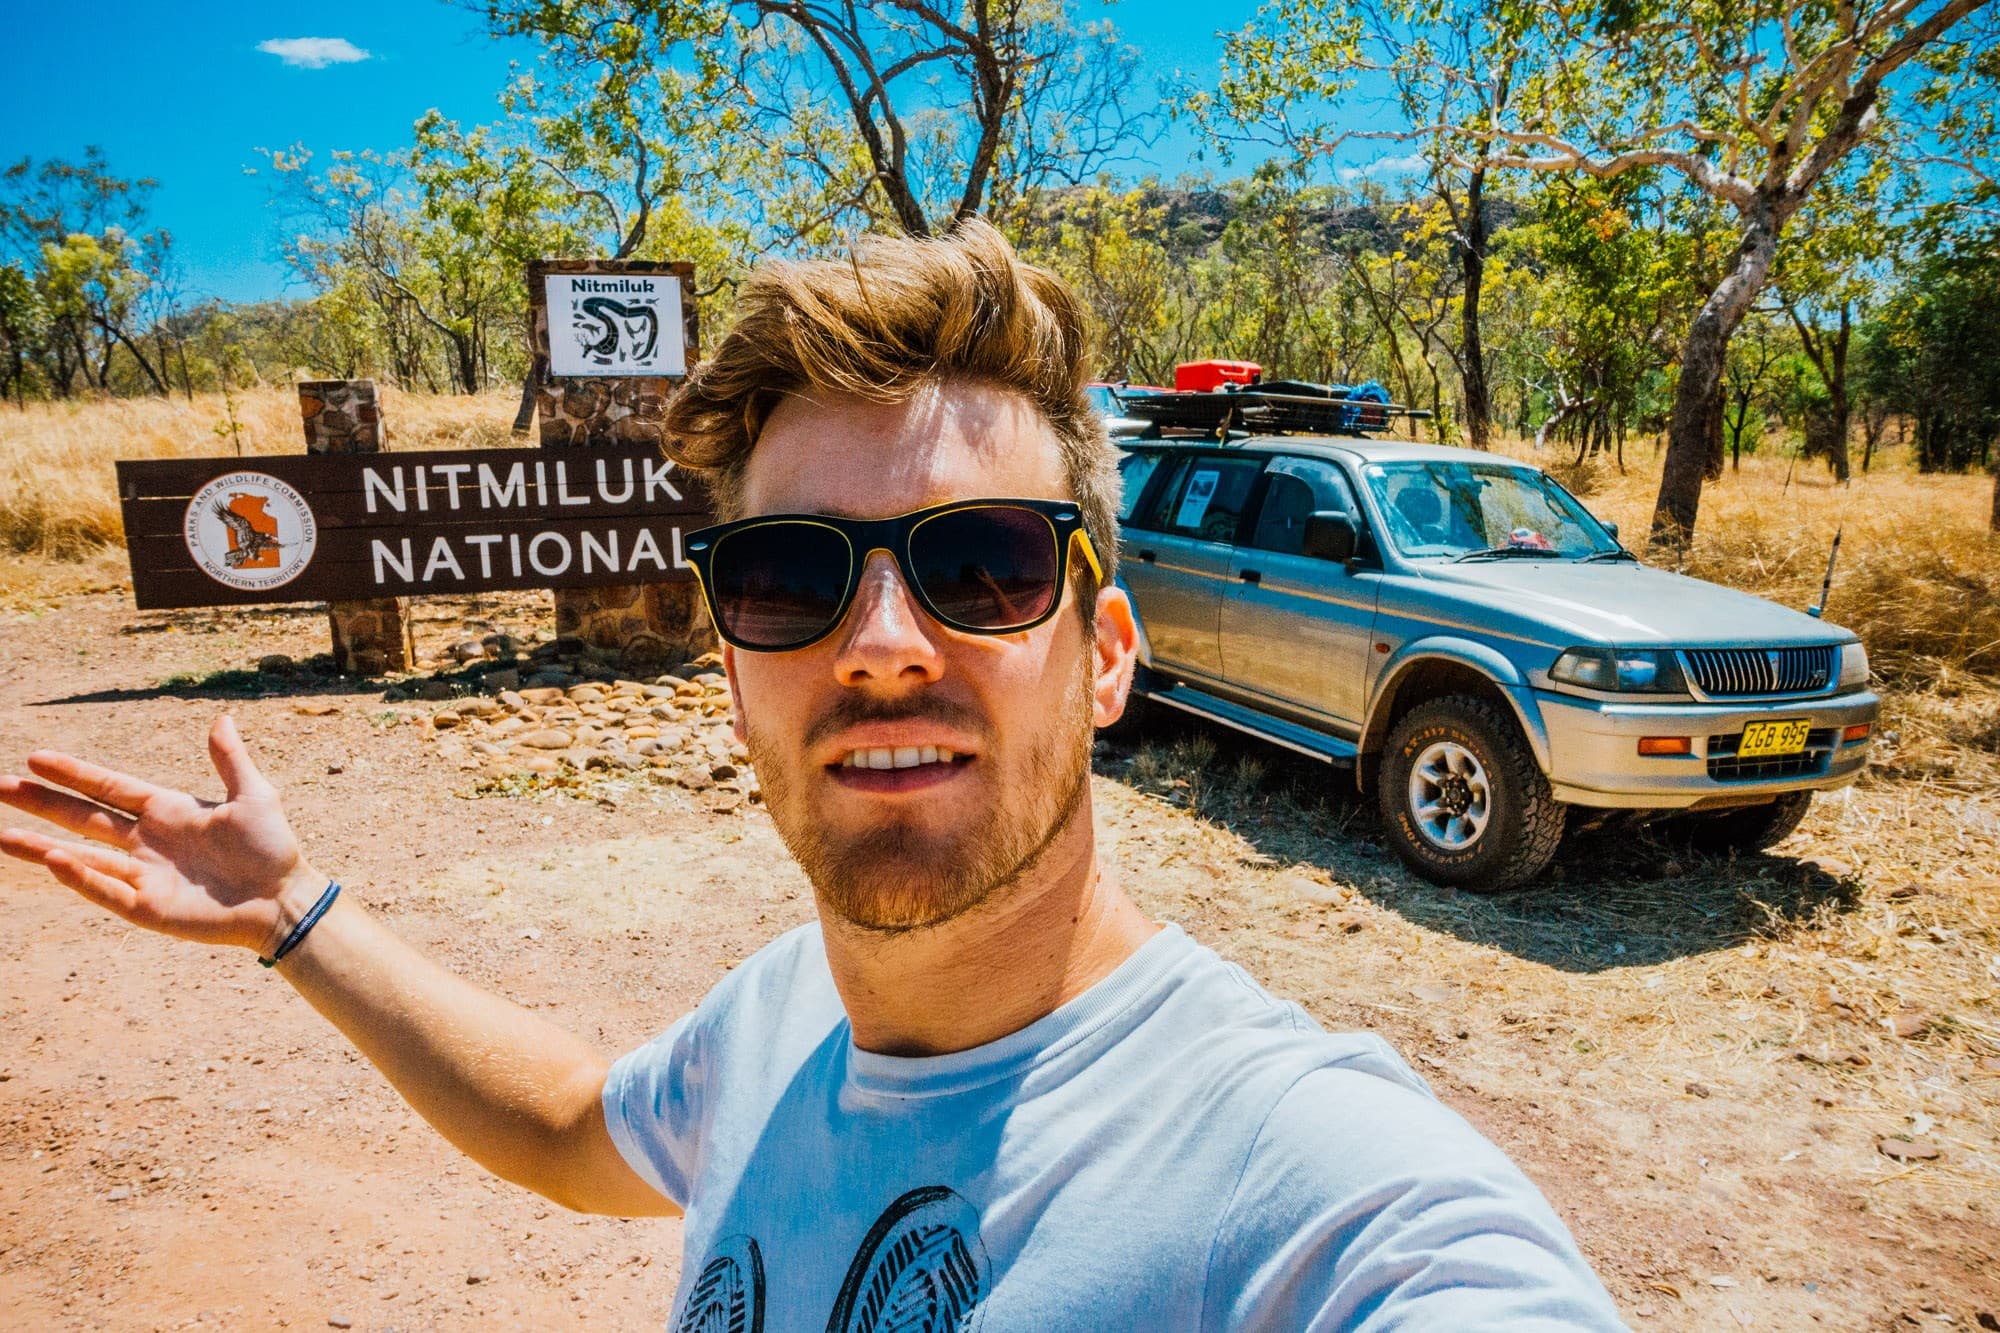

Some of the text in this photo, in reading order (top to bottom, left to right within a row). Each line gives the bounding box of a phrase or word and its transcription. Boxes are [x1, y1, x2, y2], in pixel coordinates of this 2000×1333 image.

[571, 279, 655, 293] Nitmiluk
[363, 458, 684, 513] NITMILUK
[187, 475, 314, 547] PARKS AND WILDLIFE COMMISSION
[203, 558, 306, 588] NORTHERN TERRITORY
[371, 527, 691, 584] NATIONAL
[1743, 724, 1809, 749] ZGB 995
